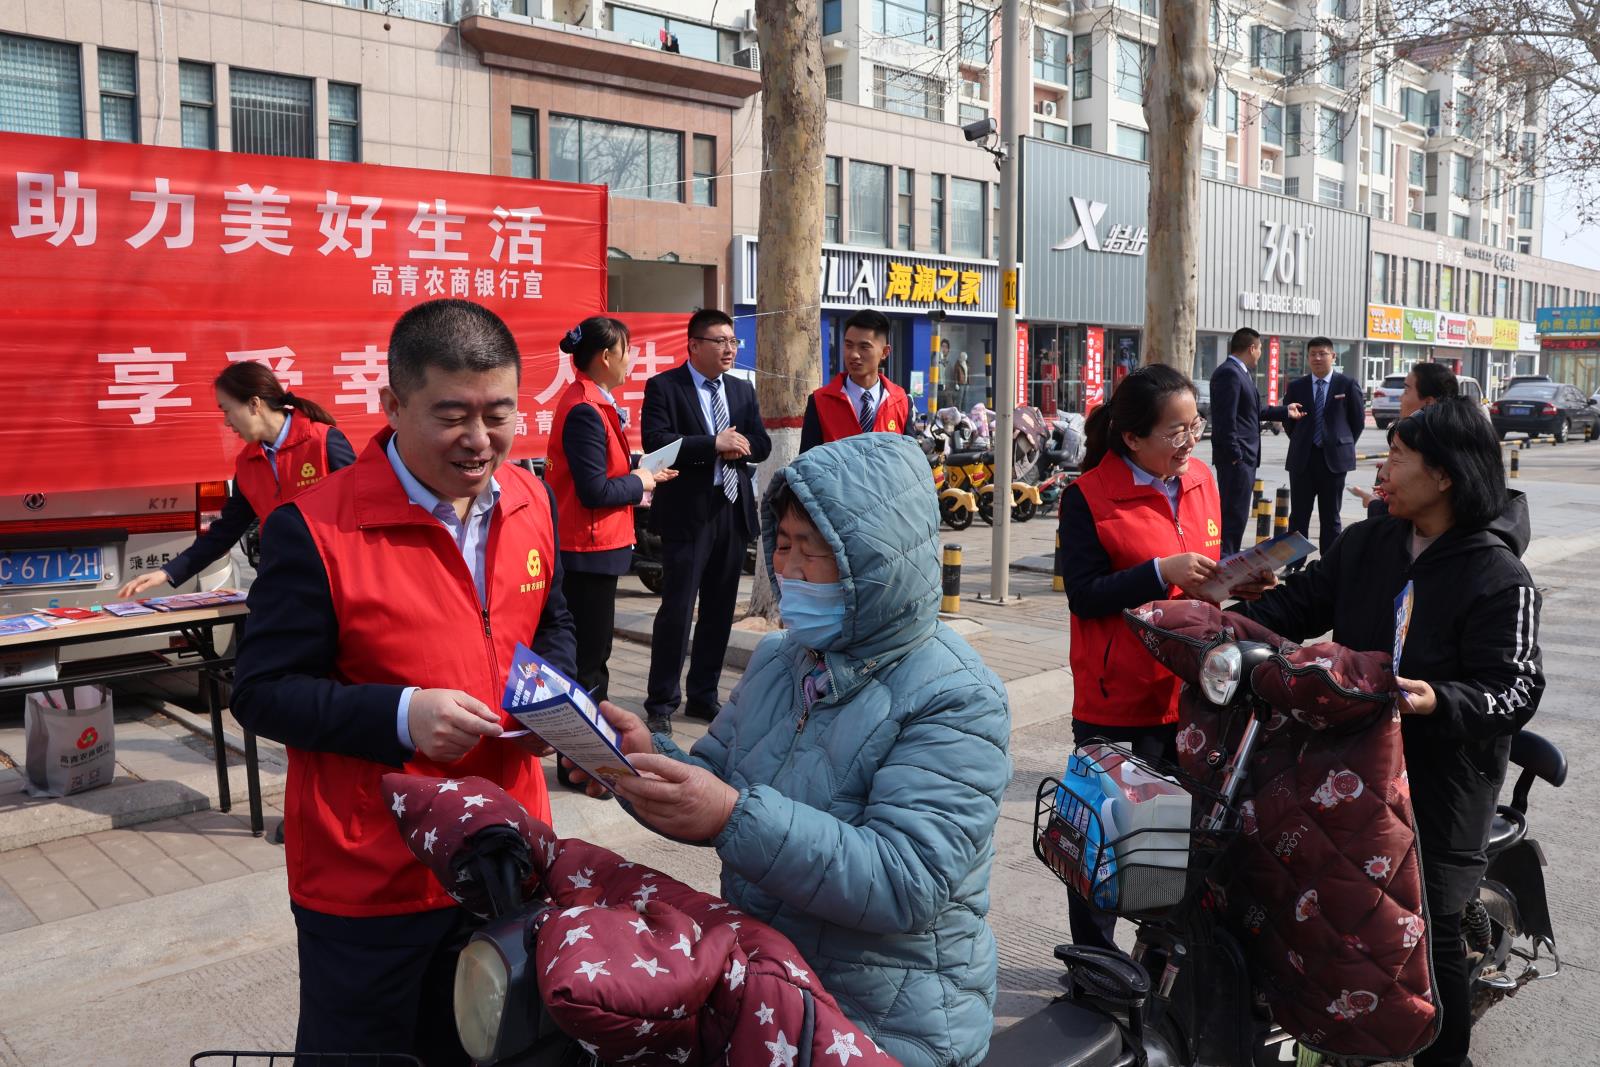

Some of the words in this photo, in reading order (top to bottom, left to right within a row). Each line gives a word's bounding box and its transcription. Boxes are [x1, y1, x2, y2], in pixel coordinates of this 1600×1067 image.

[11, 171, 546, 265] 助力美好生活
[371, 264, 543, 299] 高青农商银行宣
[819, 255, 877, 299] LA
[886, 261, 983, 305] 海澜之家
[1241, 291, 1260, 312] ONE
[1261, 294, 1292, 314] DEGREE
[1293, 296, 1321, 316] BEYOND
[149, 497, 178, 510] K17
